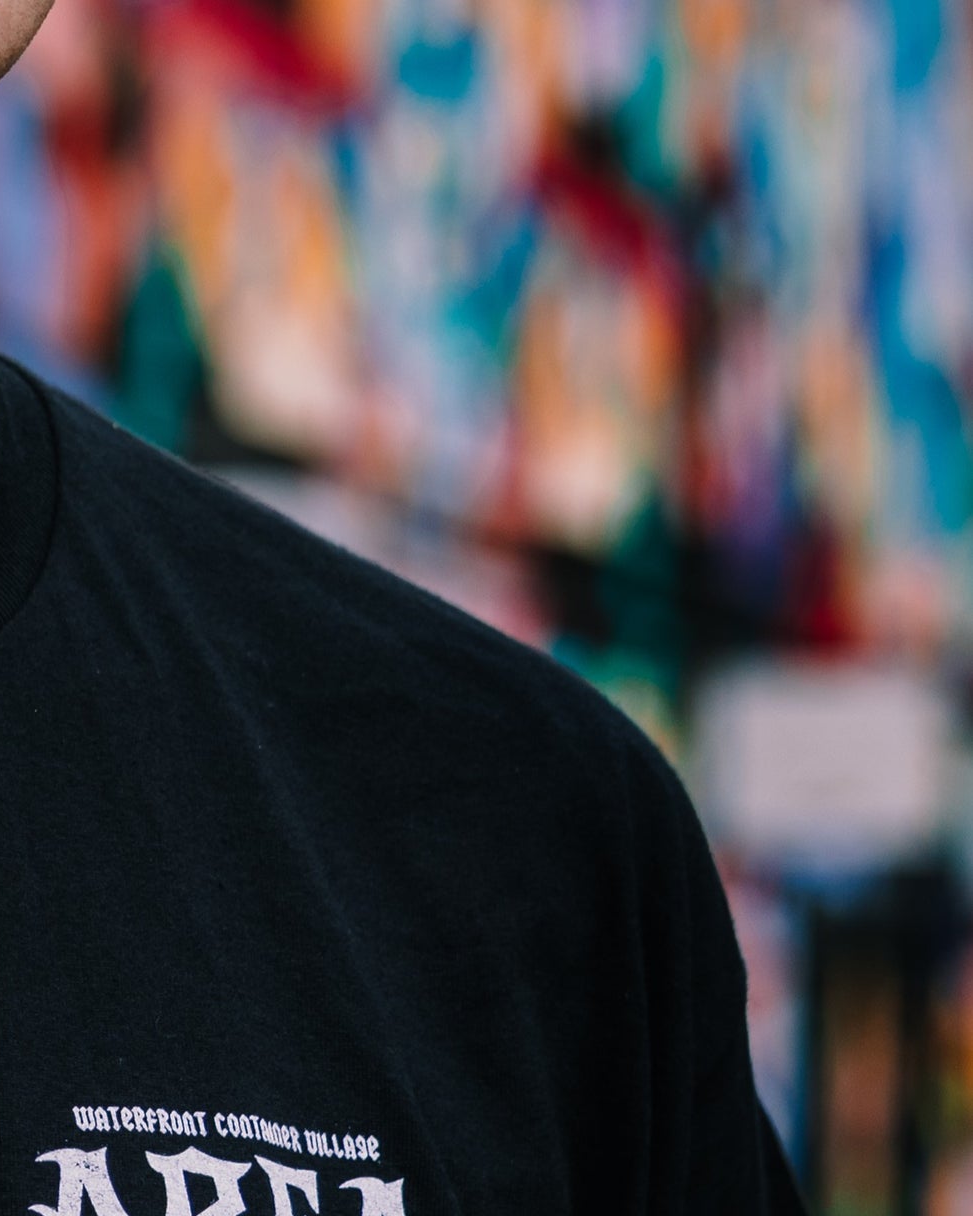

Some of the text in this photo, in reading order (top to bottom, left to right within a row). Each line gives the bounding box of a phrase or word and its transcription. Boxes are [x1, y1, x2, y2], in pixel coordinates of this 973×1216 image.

[71, 1105, 381, 1162] WATERFRONT CONTAINER VILLAGE
